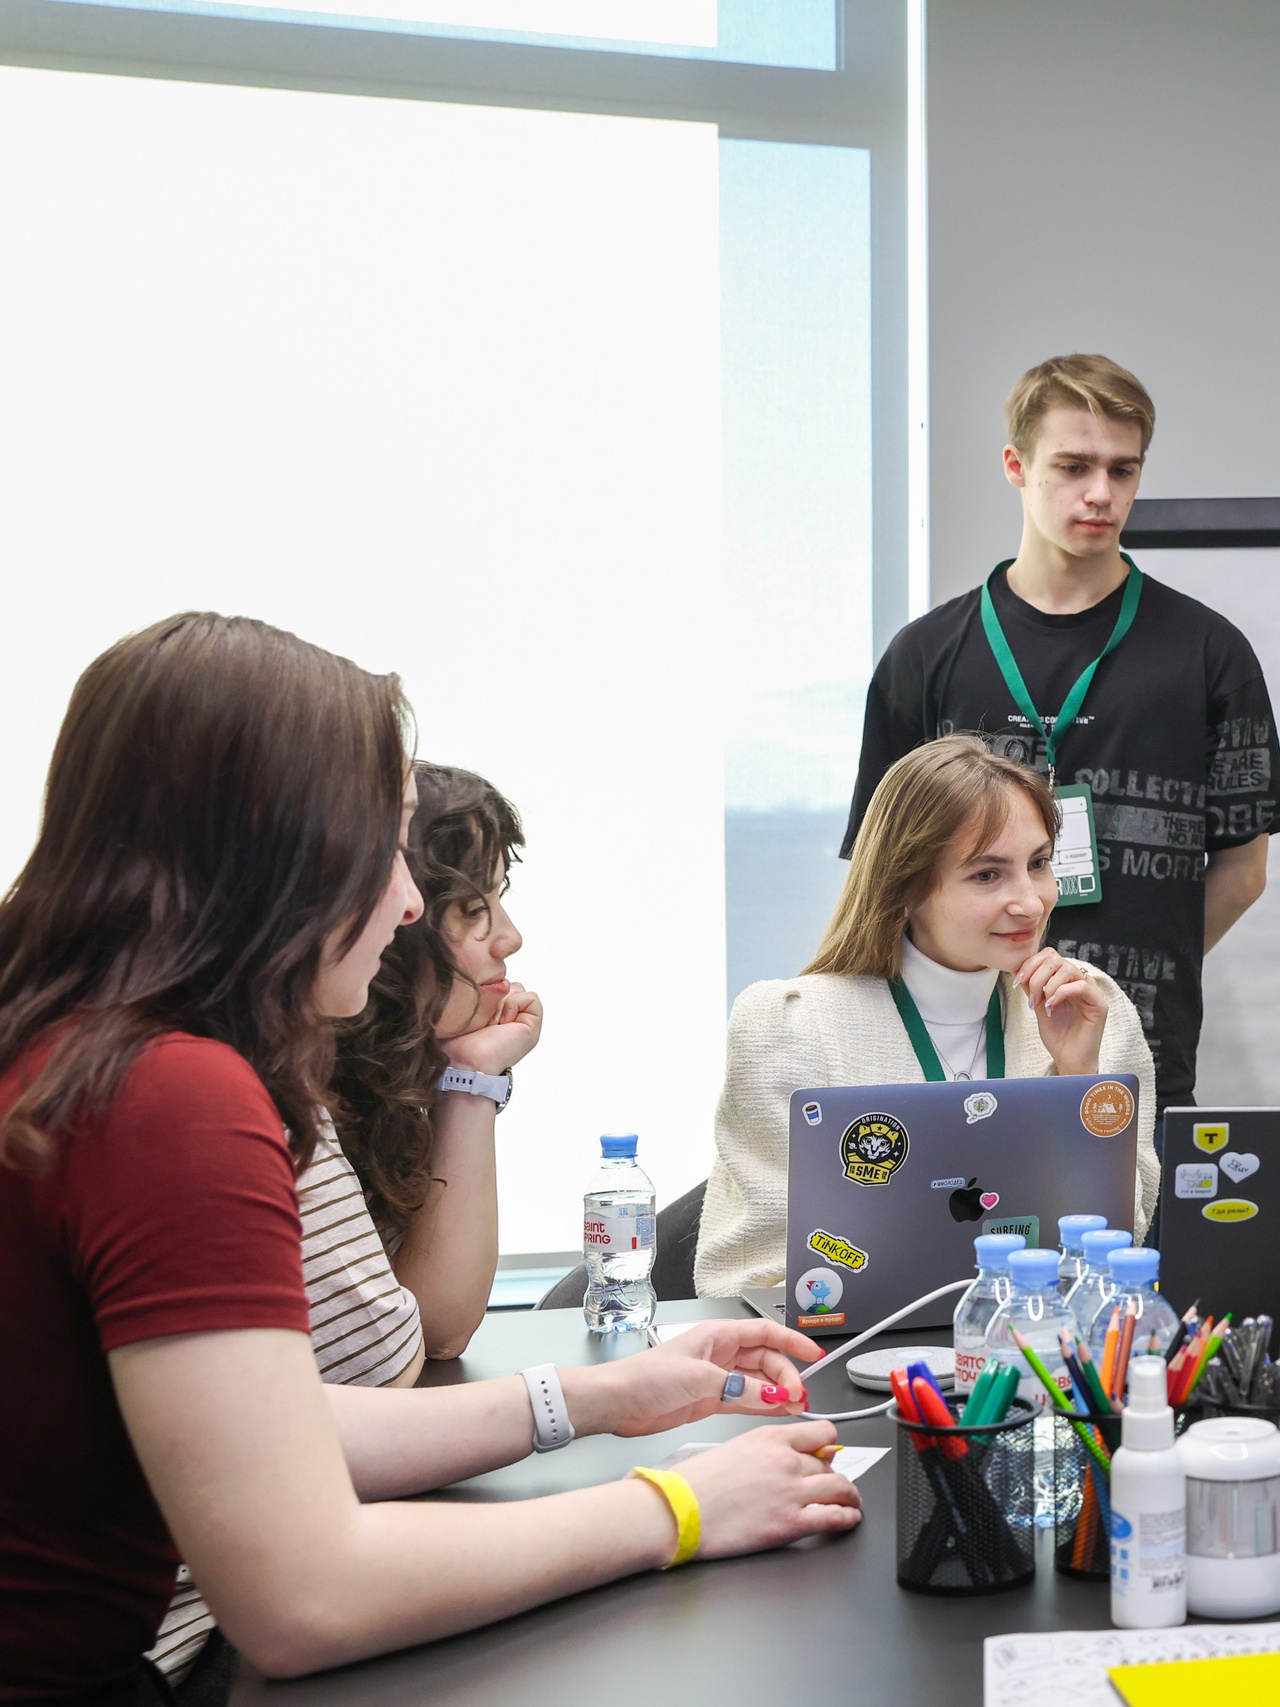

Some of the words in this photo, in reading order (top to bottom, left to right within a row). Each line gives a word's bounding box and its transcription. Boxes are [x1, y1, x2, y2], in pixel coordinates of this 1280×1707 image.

[1074, 767, 1206, 809] COLLECTI
[1090, 1085, 1107, 1097] TIMES
[1114, 1086, 1125, 1095] THE
[861, 1115, 901, 1131] ORIGINATION
[856, 1165, 881, 1180] SME
[583, 1232, 611, 1245] PRING
